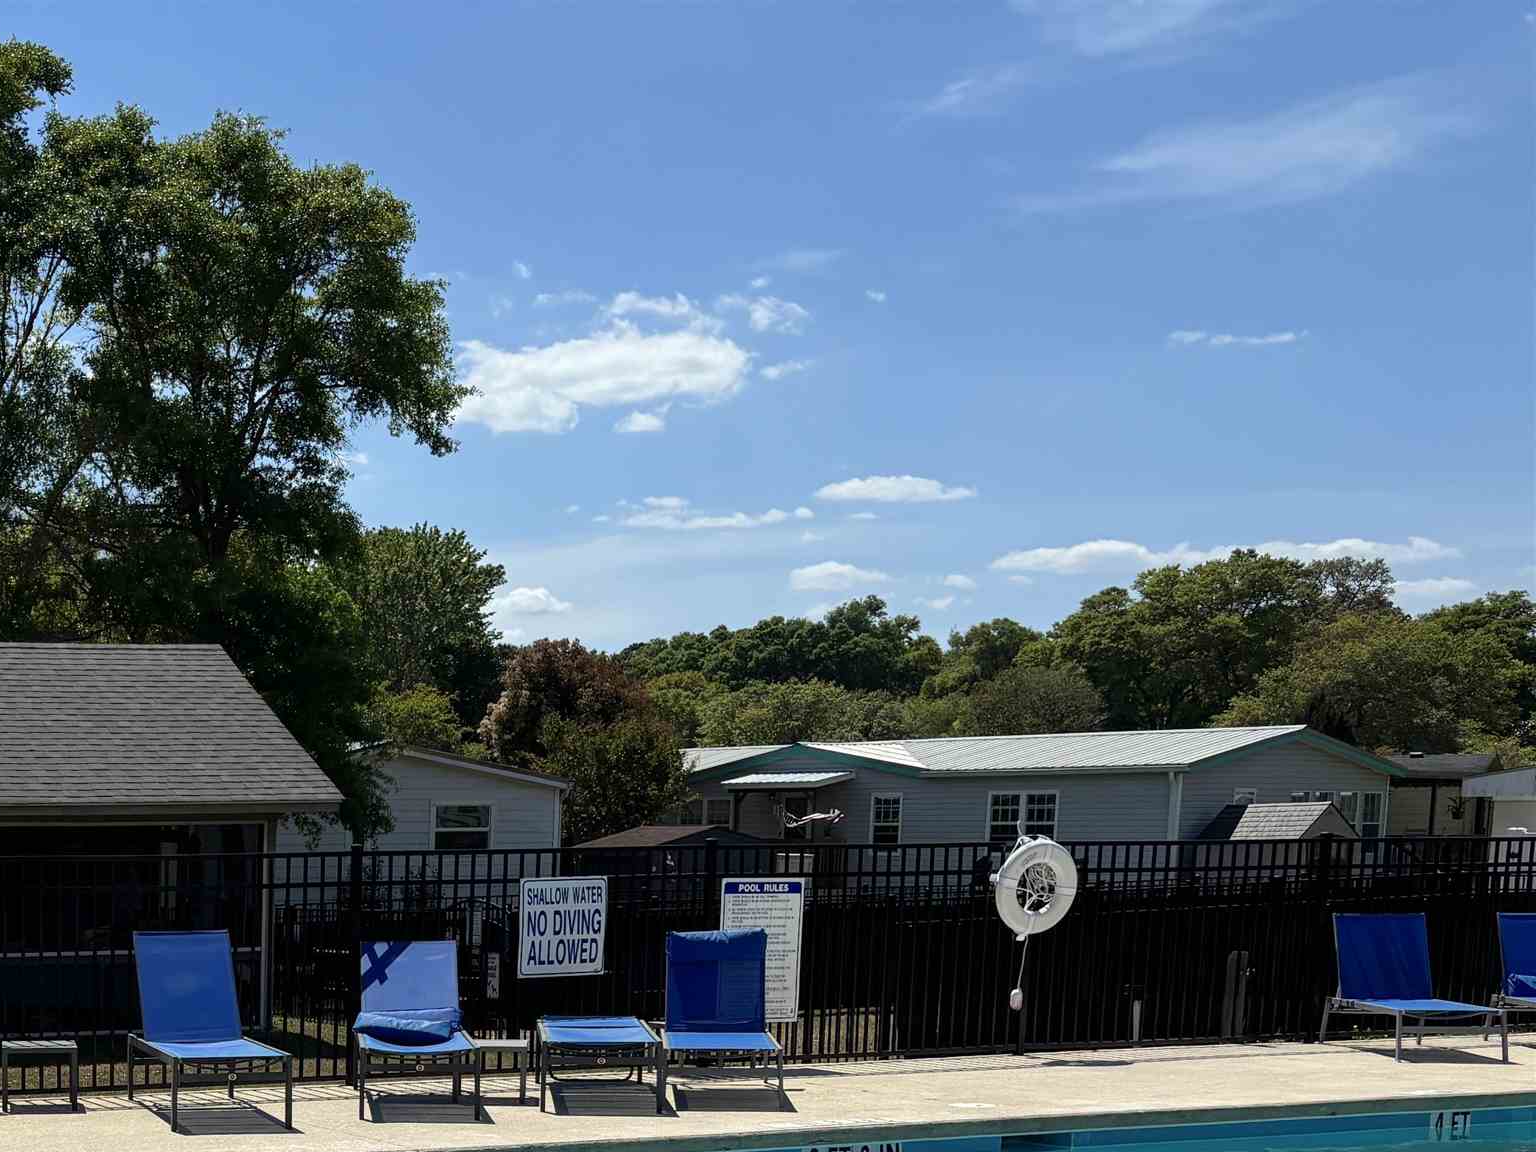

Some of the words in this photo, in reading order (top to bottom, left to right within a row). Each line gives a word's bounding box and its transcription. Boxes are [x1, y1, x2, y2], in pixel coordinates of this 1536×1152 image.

[527, 887, 569, 906] SHALLOW
[573, 885, 603, 904] WATER
[738, 883, 760, 893] POOL
[763, 883, 789, 892] RULES
[527, 910, 547, 937] NO
[553, 908, 601, 935] DIVING
[527, 938, 598, 966] ALLOWED
